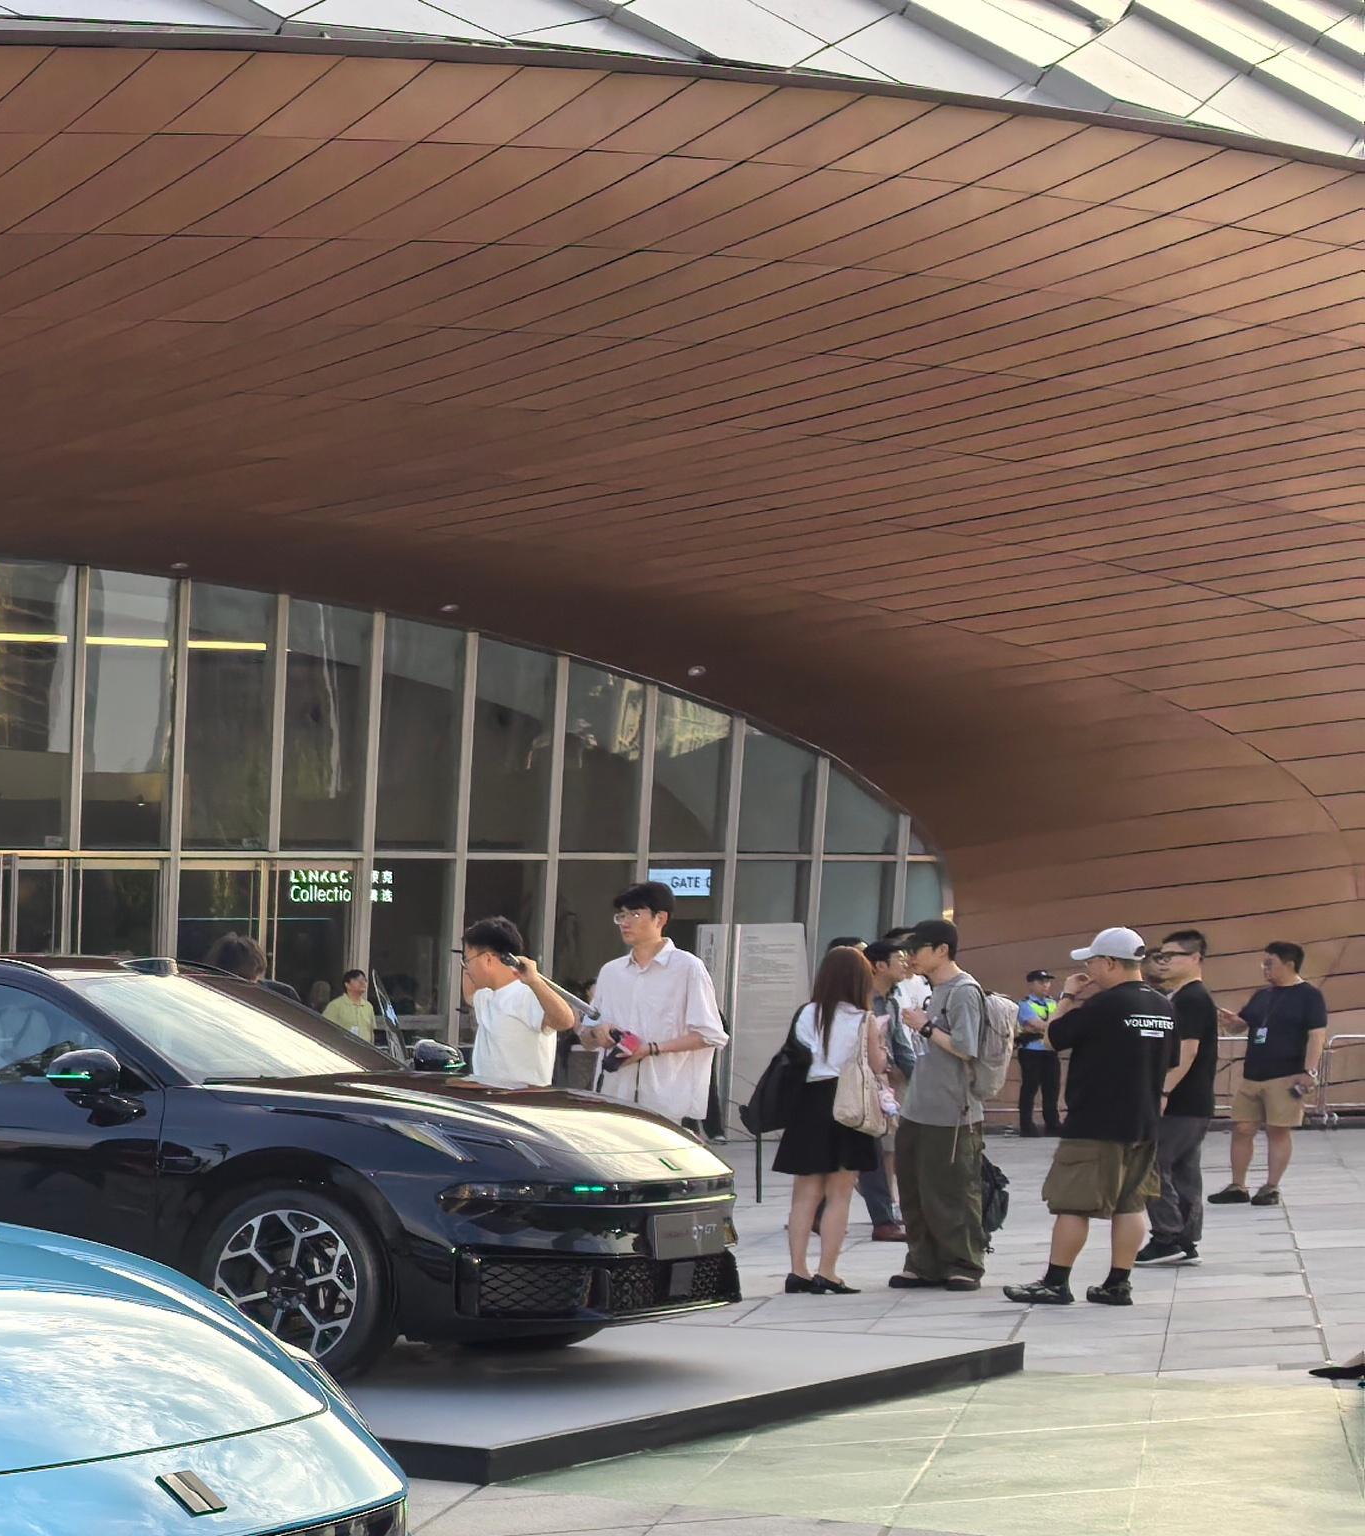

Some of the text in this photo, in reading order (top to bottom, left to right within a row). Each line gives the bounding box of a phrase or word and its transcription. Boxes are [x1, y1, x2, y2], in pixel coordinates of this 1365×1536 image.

[289, 869, 352, 883] LYNK&C
[670, 876, 701, 889] GATE
[290, 884, 352, 902] Collectio
